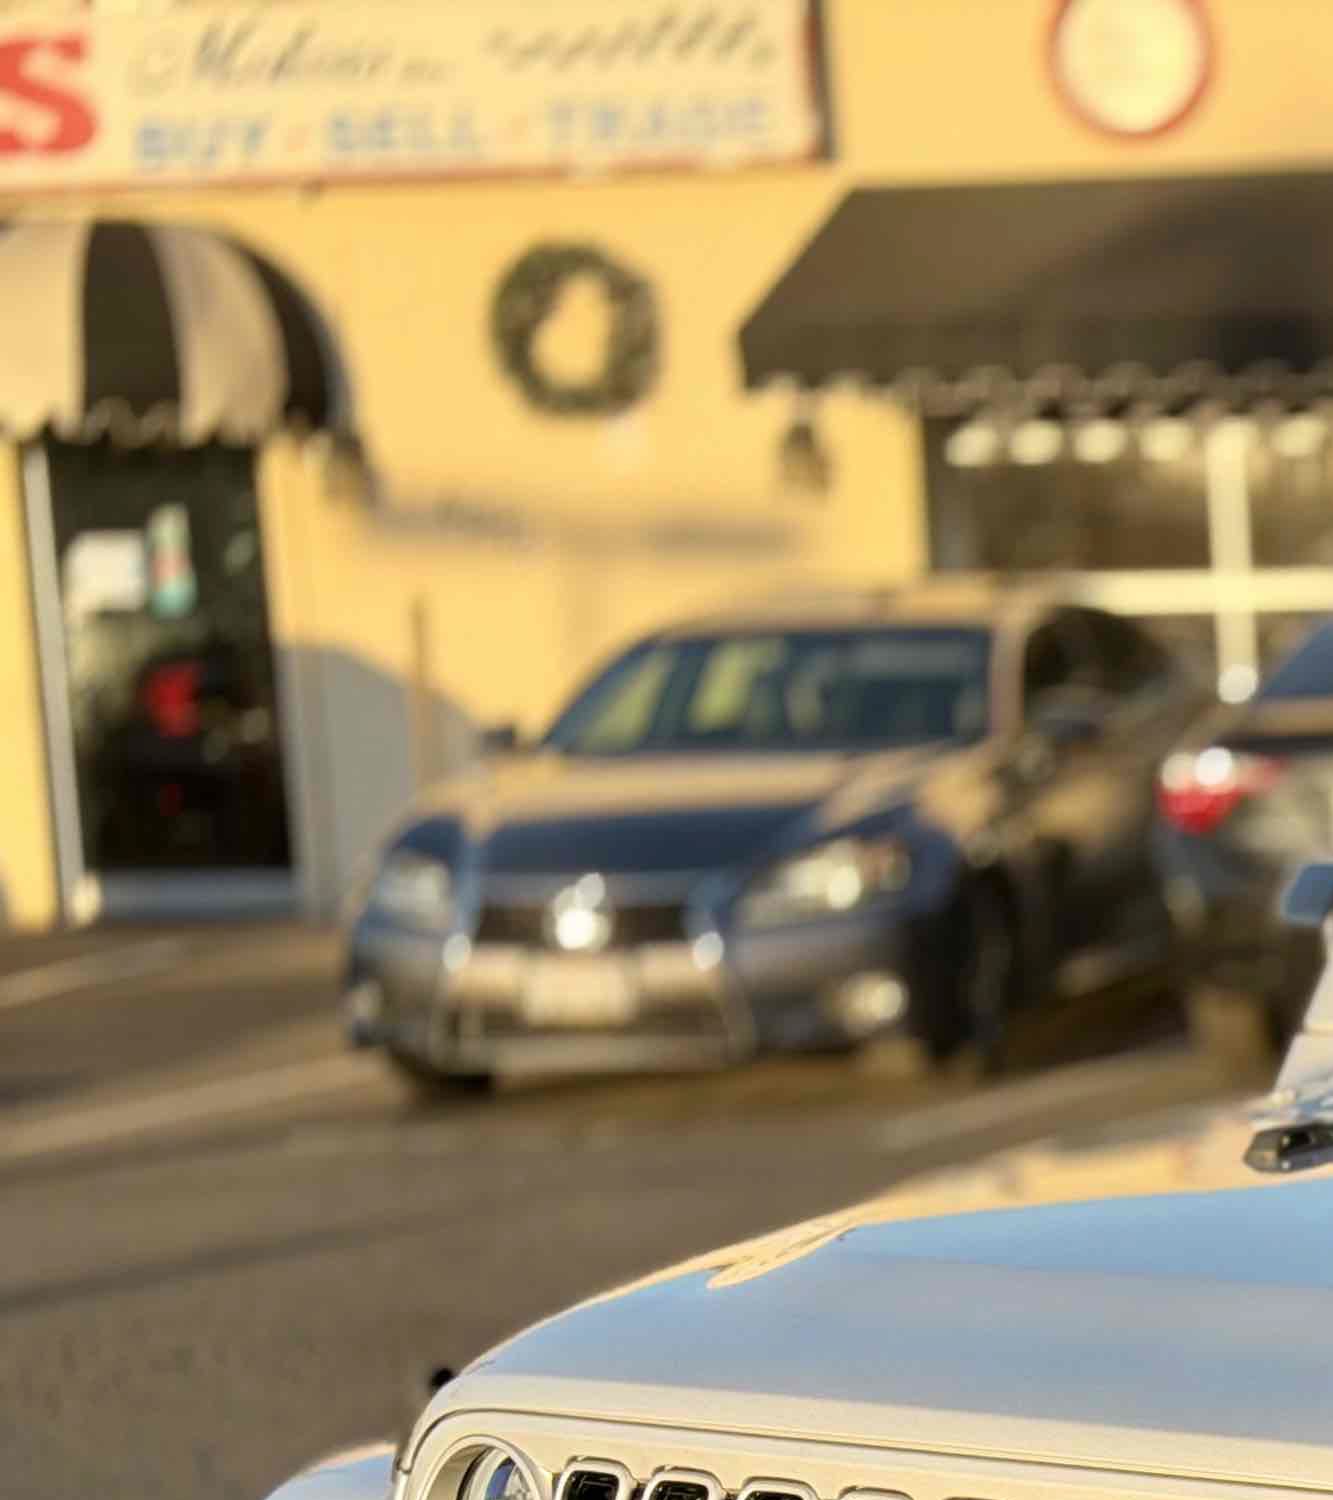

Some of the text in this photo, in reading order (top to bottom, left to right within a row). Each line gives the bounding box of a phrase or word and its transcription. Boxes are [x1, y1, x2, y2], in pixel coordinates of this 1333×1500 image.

[135, 98, 768, 171] BUY SELL TRADE
